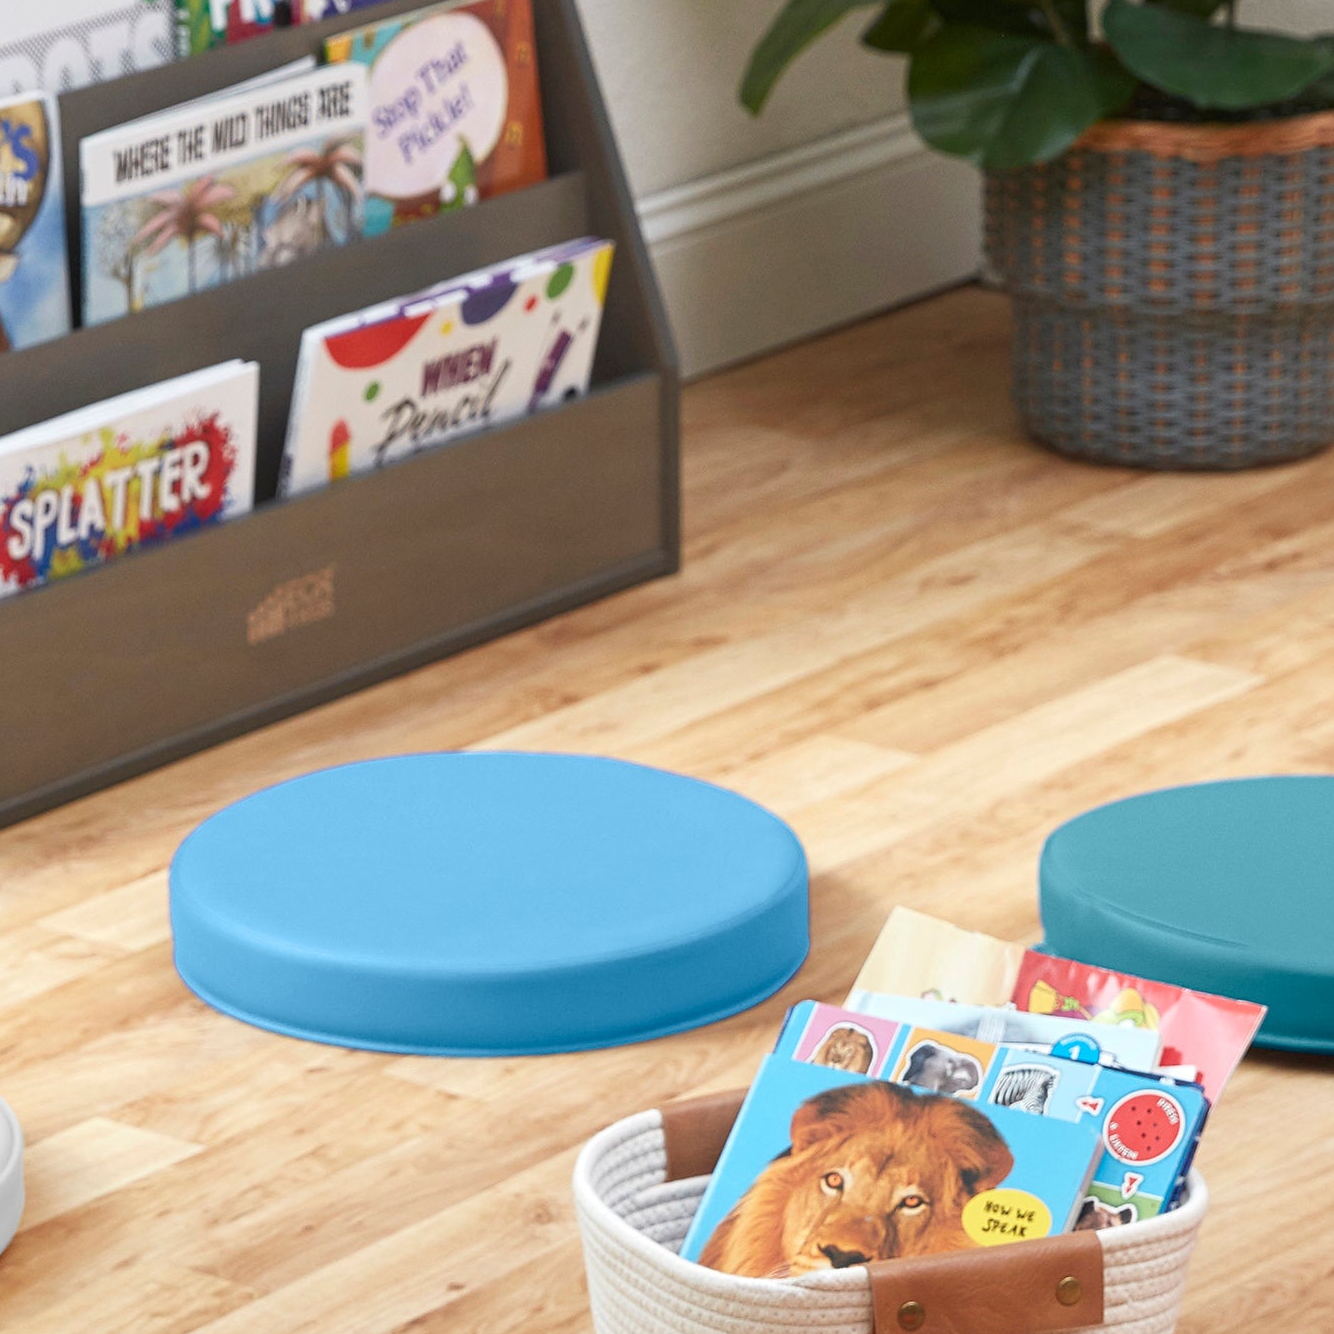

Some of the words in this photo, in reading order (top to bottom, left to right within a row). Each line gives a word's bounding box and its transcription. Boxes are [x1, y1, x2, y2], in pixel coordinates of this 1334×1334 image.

[113, 135, 172, 183] WHERE
[177, 124, 207, 164] THE
[212, 112, 250, 154] WILD
[255, 98, 310, 142] THINGS
[317, 80, 353, 120] ARE
[372, 86, 421, 140] Stop
[418, 41, 469, 95] That
[375, 357, 512, 469] Pencil
[422, 334, 499, 398] WHEN
[7, 440, 213, 561] SPLATTER
[982, 1218, 1027, 1237] SPEAK
[983, 1200, 1012, 1216] HOW
[1017, 1208, 1035, 1222] WE
